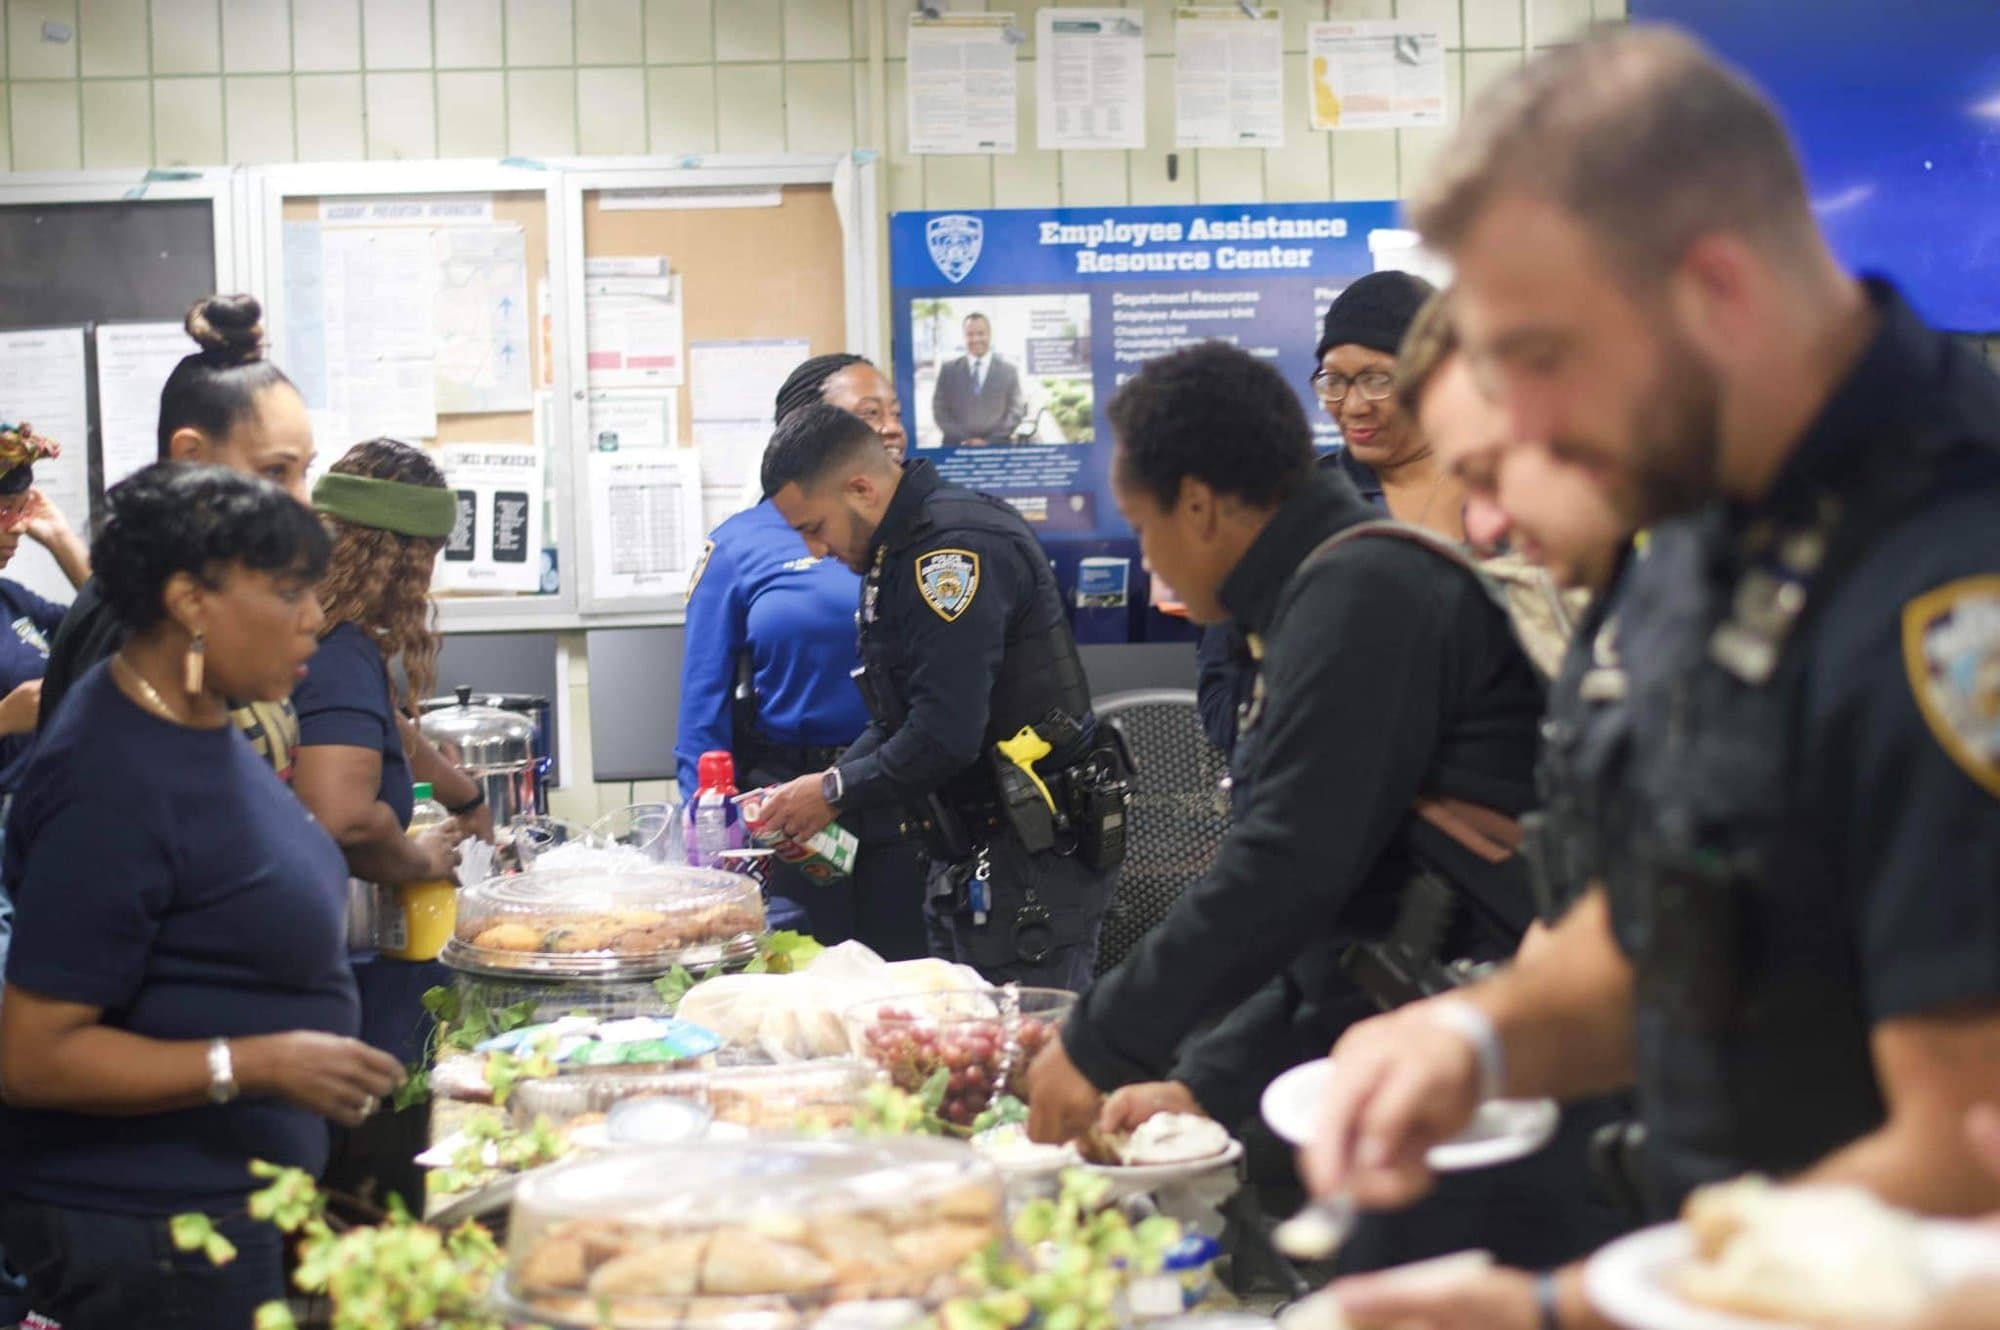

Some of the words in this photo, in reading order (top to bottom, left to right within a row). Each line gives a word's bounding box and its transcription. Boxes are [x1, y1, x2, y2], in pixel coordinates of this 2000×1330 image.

[1039, 219, 1182, 247] Employee
[1188, 216, 1347, 241] Assistance
[1076, 249, 1211, 273] Resource
[1216, 246, 1314, 270] Center
[1113, 292, 1189, 307] Department
[1191, 290, 1261, 304] Resources
[1113, 310, 1167, 323] Employee
[1169, 308, 1229, 320] Assistance
